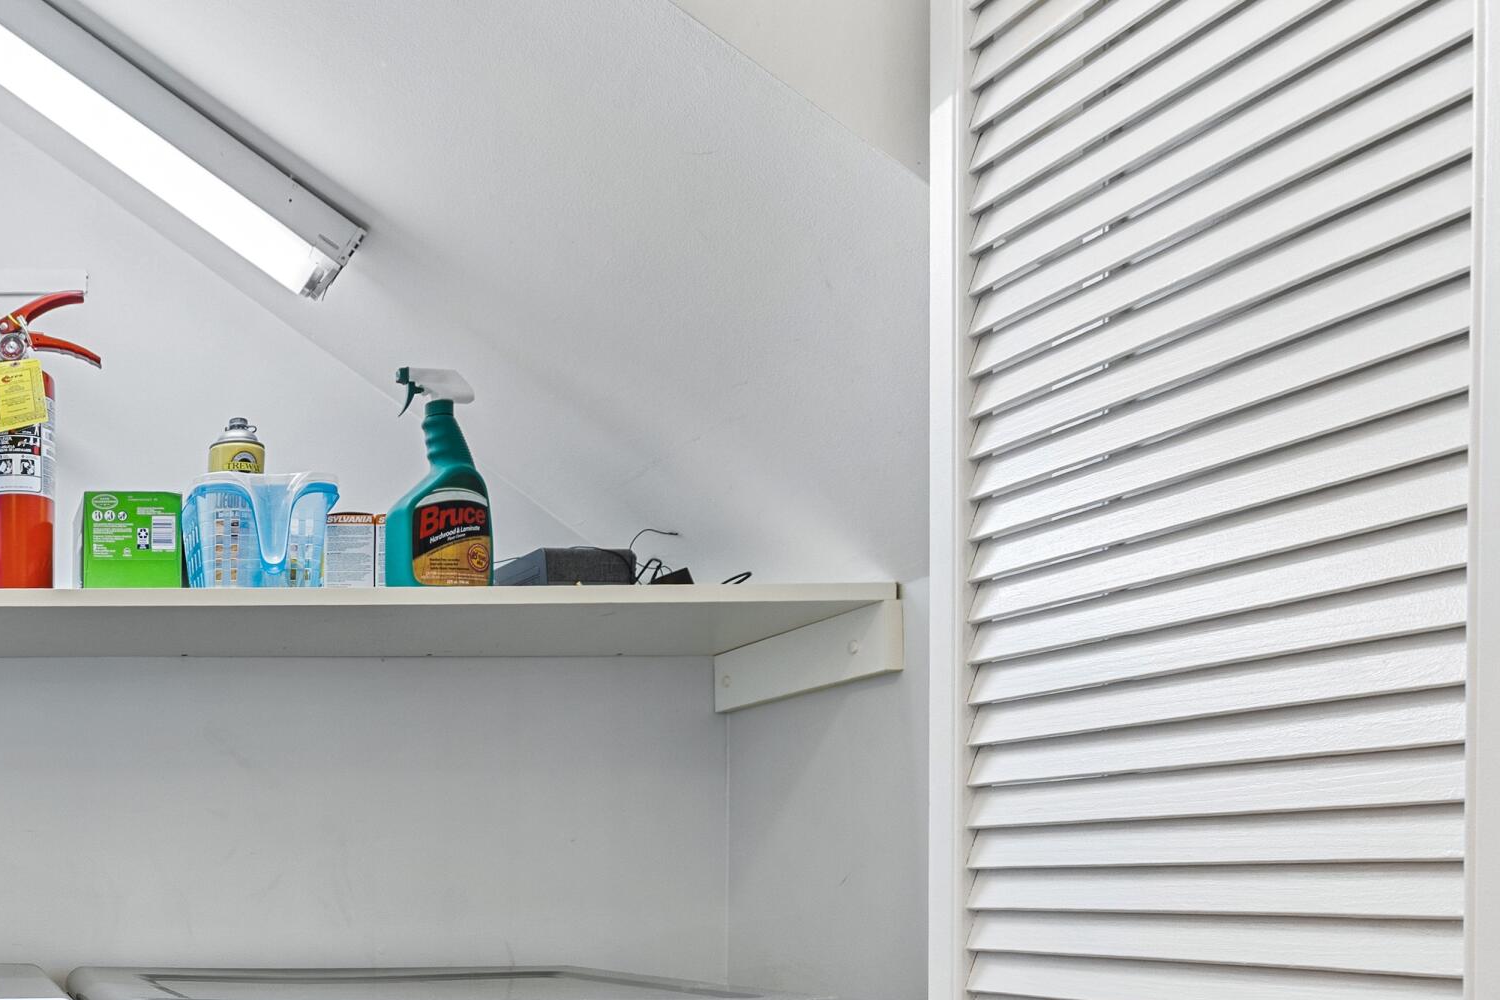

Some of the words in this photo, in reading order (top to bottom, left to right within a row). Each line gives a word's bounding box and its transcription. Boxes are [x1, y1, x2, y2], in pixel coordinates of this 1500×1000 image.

[327, 515, 373, 523] SYLVANIA
[420, 505, 487, 540] Bruce
[429, 527, 457, 544] Hardwood
[460, 525, 481, 533] Laminate
